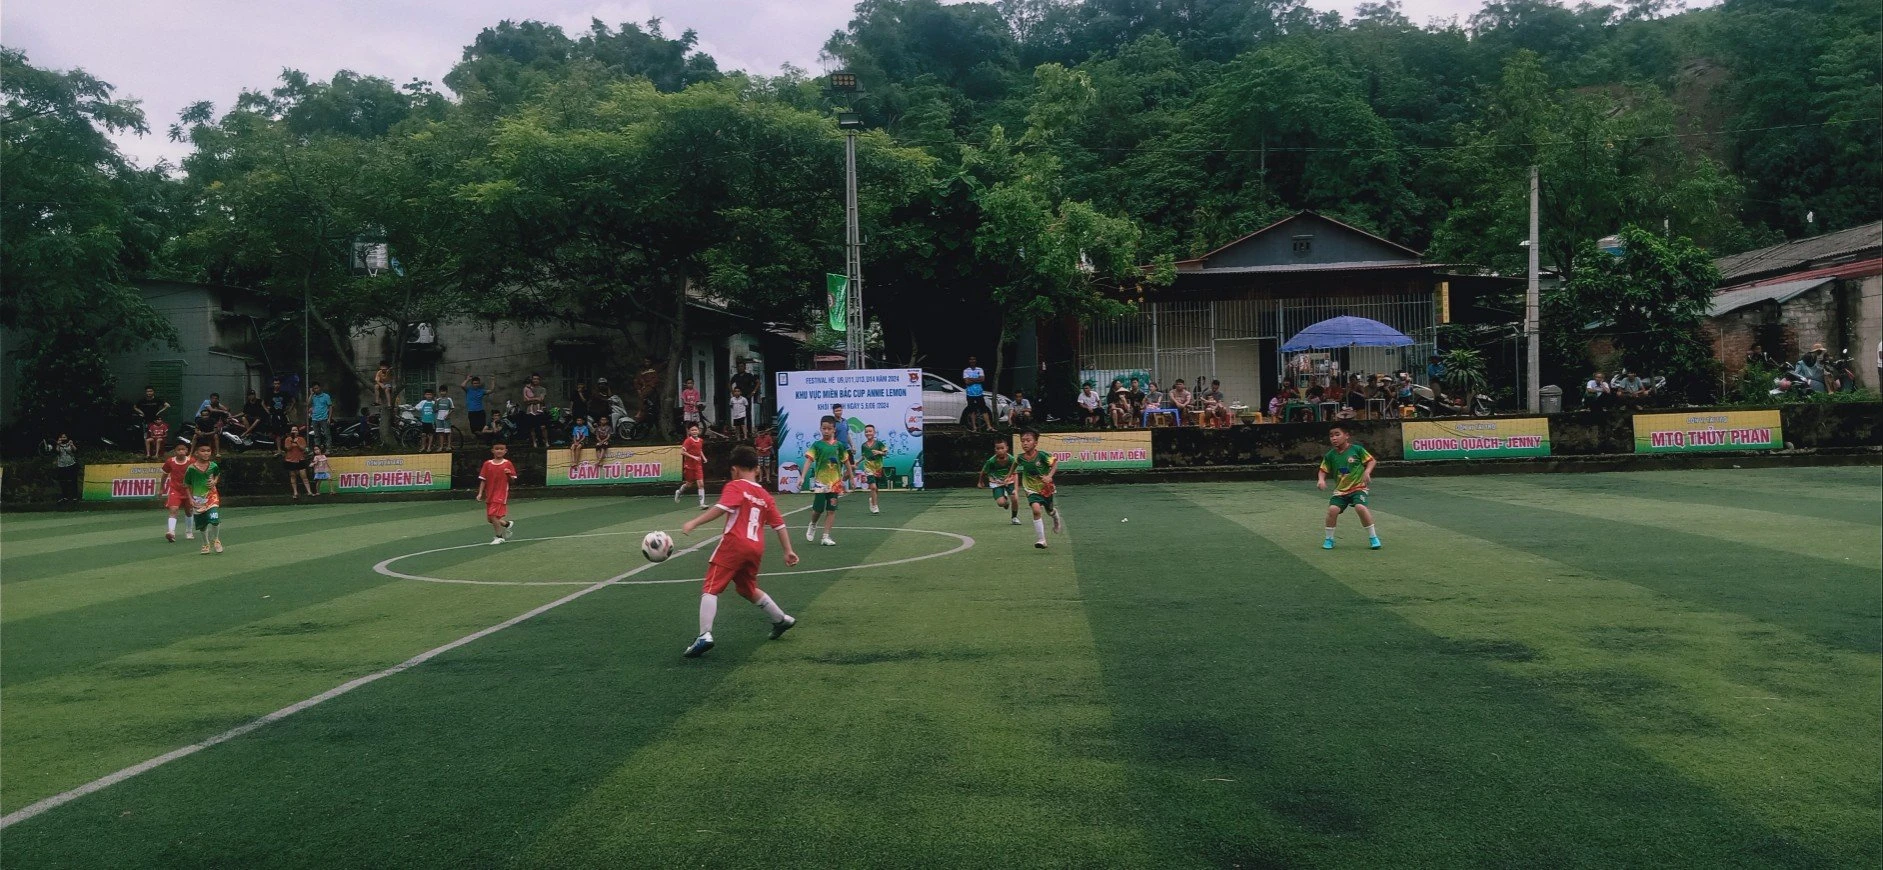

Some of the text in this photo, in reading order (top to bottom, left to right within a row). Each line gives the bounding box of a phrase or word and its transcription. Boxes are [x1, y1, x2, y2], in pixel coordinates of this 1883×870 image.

[796, 391, 808, 400] KHU
[853, 389, 865, 398] CUP
[867, 389, 884, 397] ANNIE
[886, 388, 906, 397] LEMON
[1506, 436, 1541, 448] JENNY
[1651, 427, 1771, 448] MTQ THỦY PHAN
[1053, 451, 1071, 462] OUP
[603, 461, 621, 479] TÚ
[624, 463, 661, 477] PHAN
[112, 478, 156, 497] MINH
[340, 472, 370, 488] MTQ
[747, 506, 760, 541] 8
